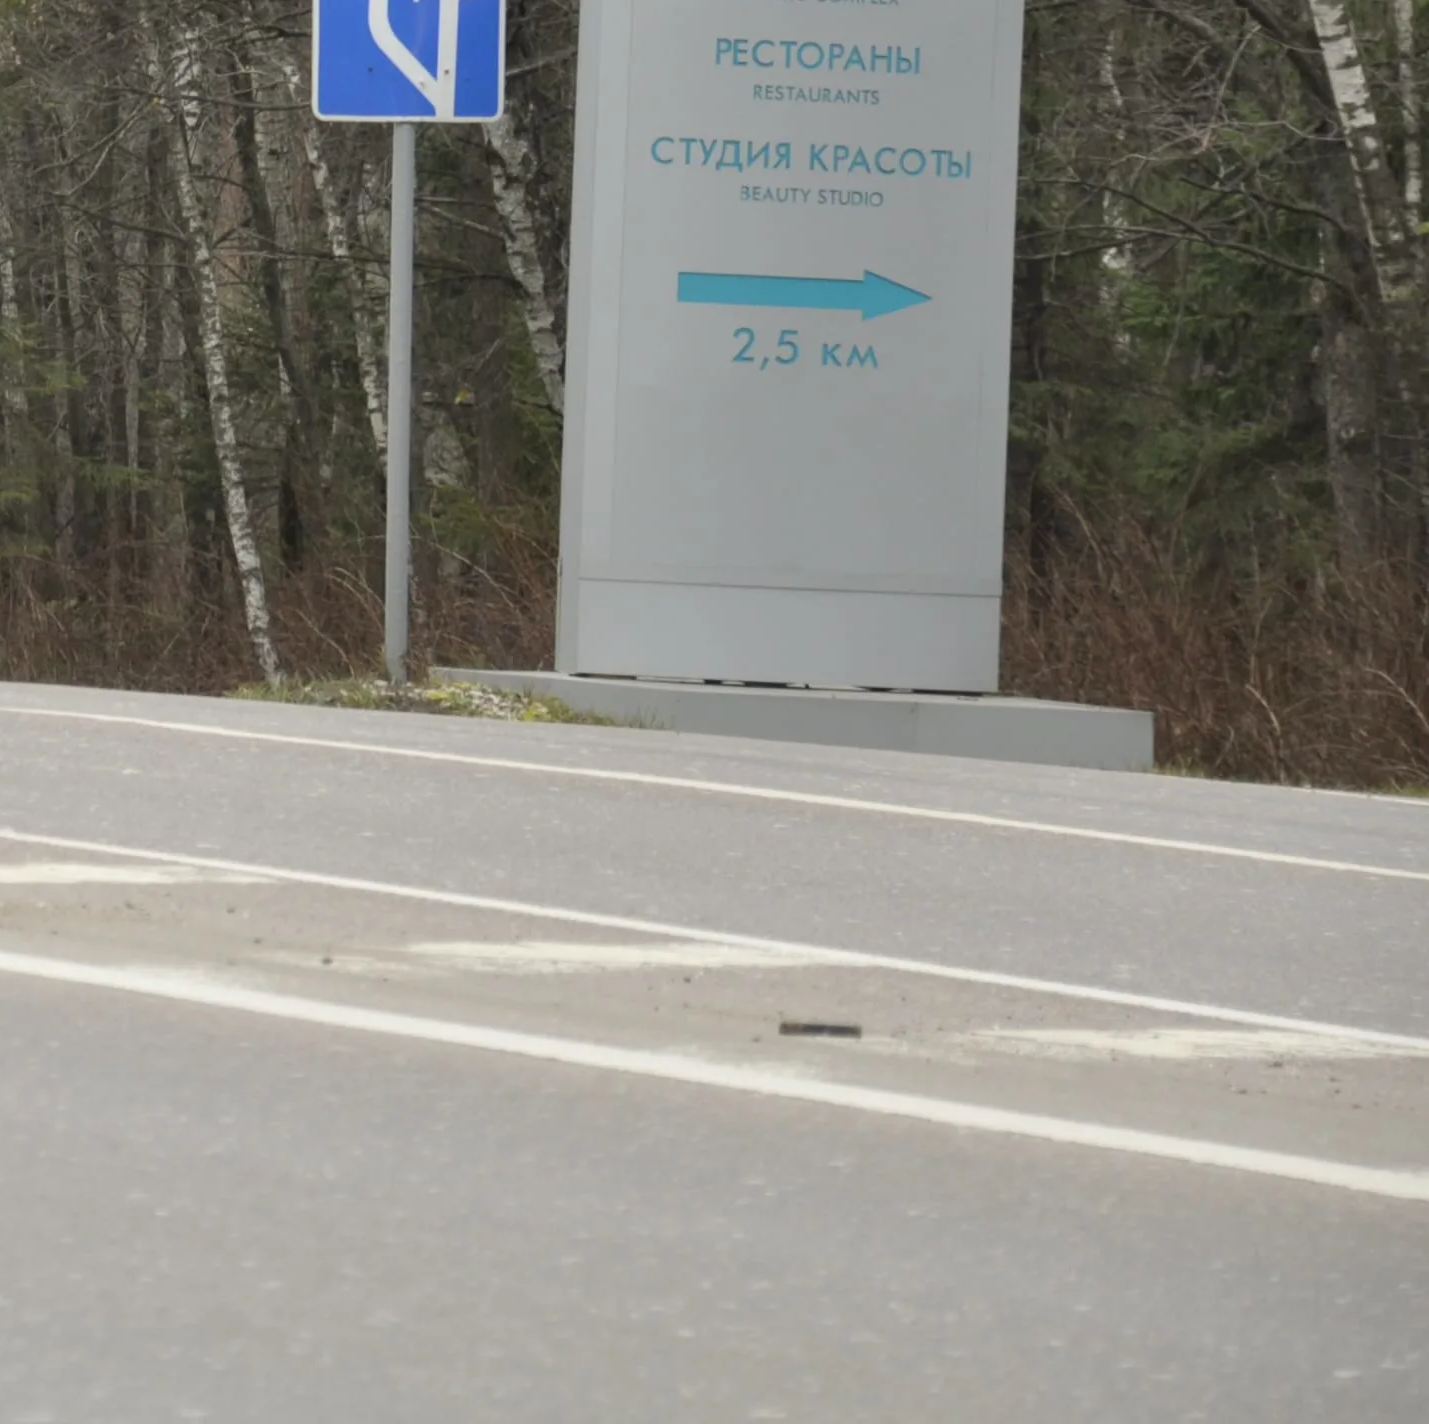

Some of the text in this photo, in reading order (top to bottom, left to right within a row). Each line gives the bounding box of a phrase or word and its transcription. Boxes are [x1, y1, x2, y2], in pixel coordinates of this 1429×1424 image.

[715, 37, 921, 75] РЕСТОРАНЫ
[753, 84, 880, 106] RESTAURANTS
[650, 136, 972, 178] СТУДИЯ КРАСОТЫ
[740, 185, 884, 207] BEAUTY STUDIO
[732, 327, 800, 369] 2,5
